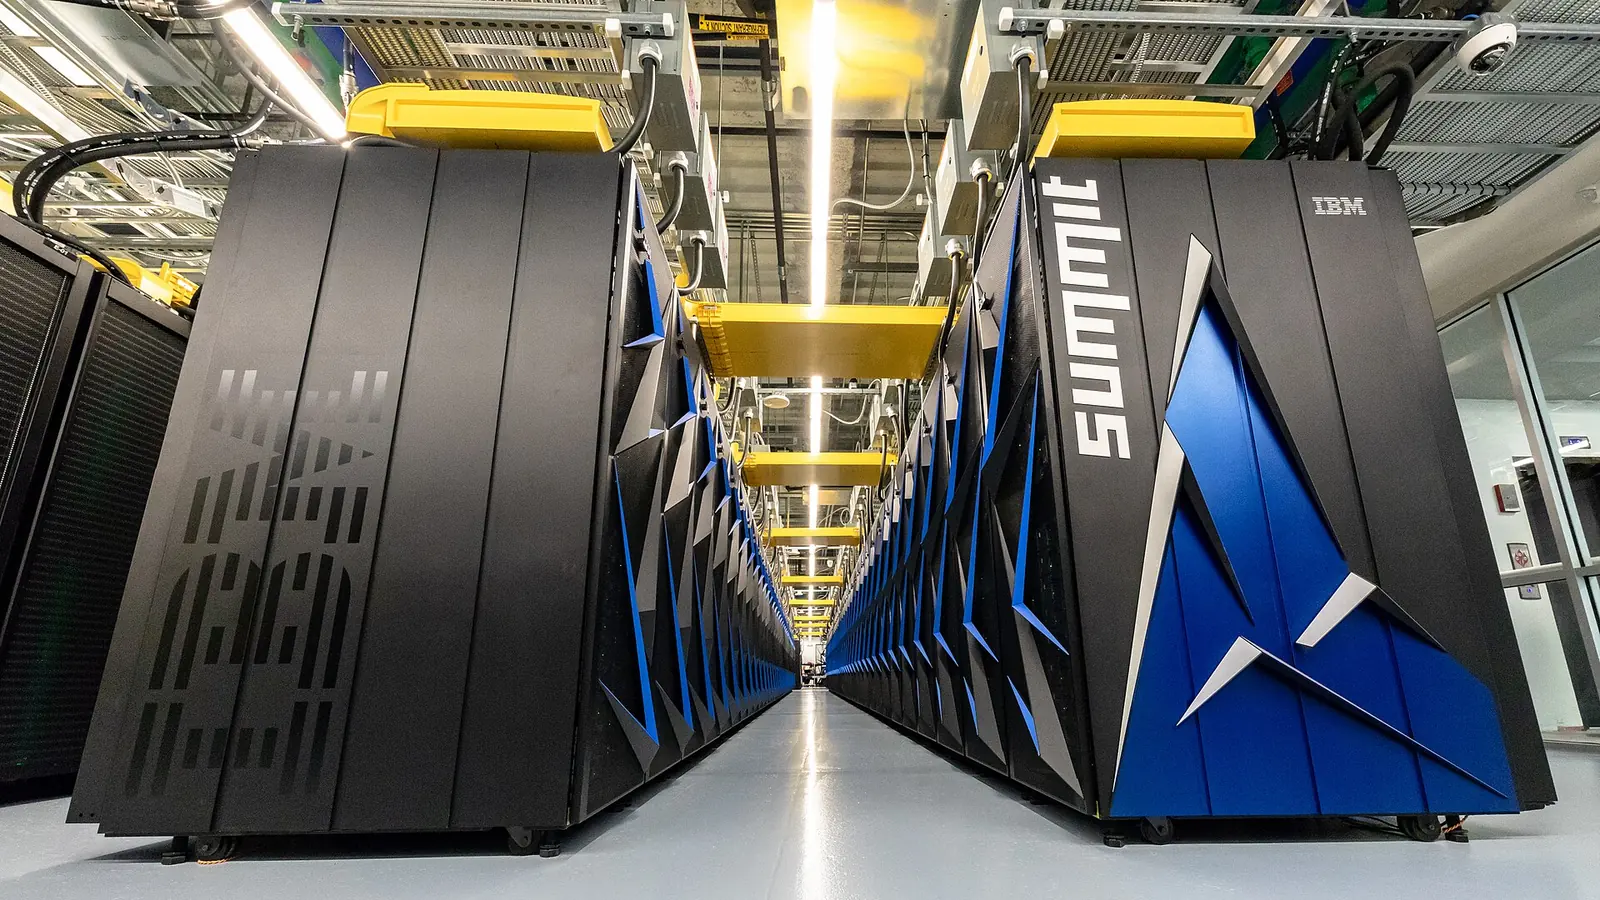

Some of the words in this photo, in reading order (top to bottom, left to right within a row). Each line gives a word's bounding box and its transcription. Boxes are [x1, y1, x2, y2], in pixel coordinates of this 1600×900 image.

[711, 21, 732, 32] SUCTION
[1312, 196, 1367, 216] IBM
[1042, 175, 1131, 459] summit
[124, 369, 389, 797] IBM
